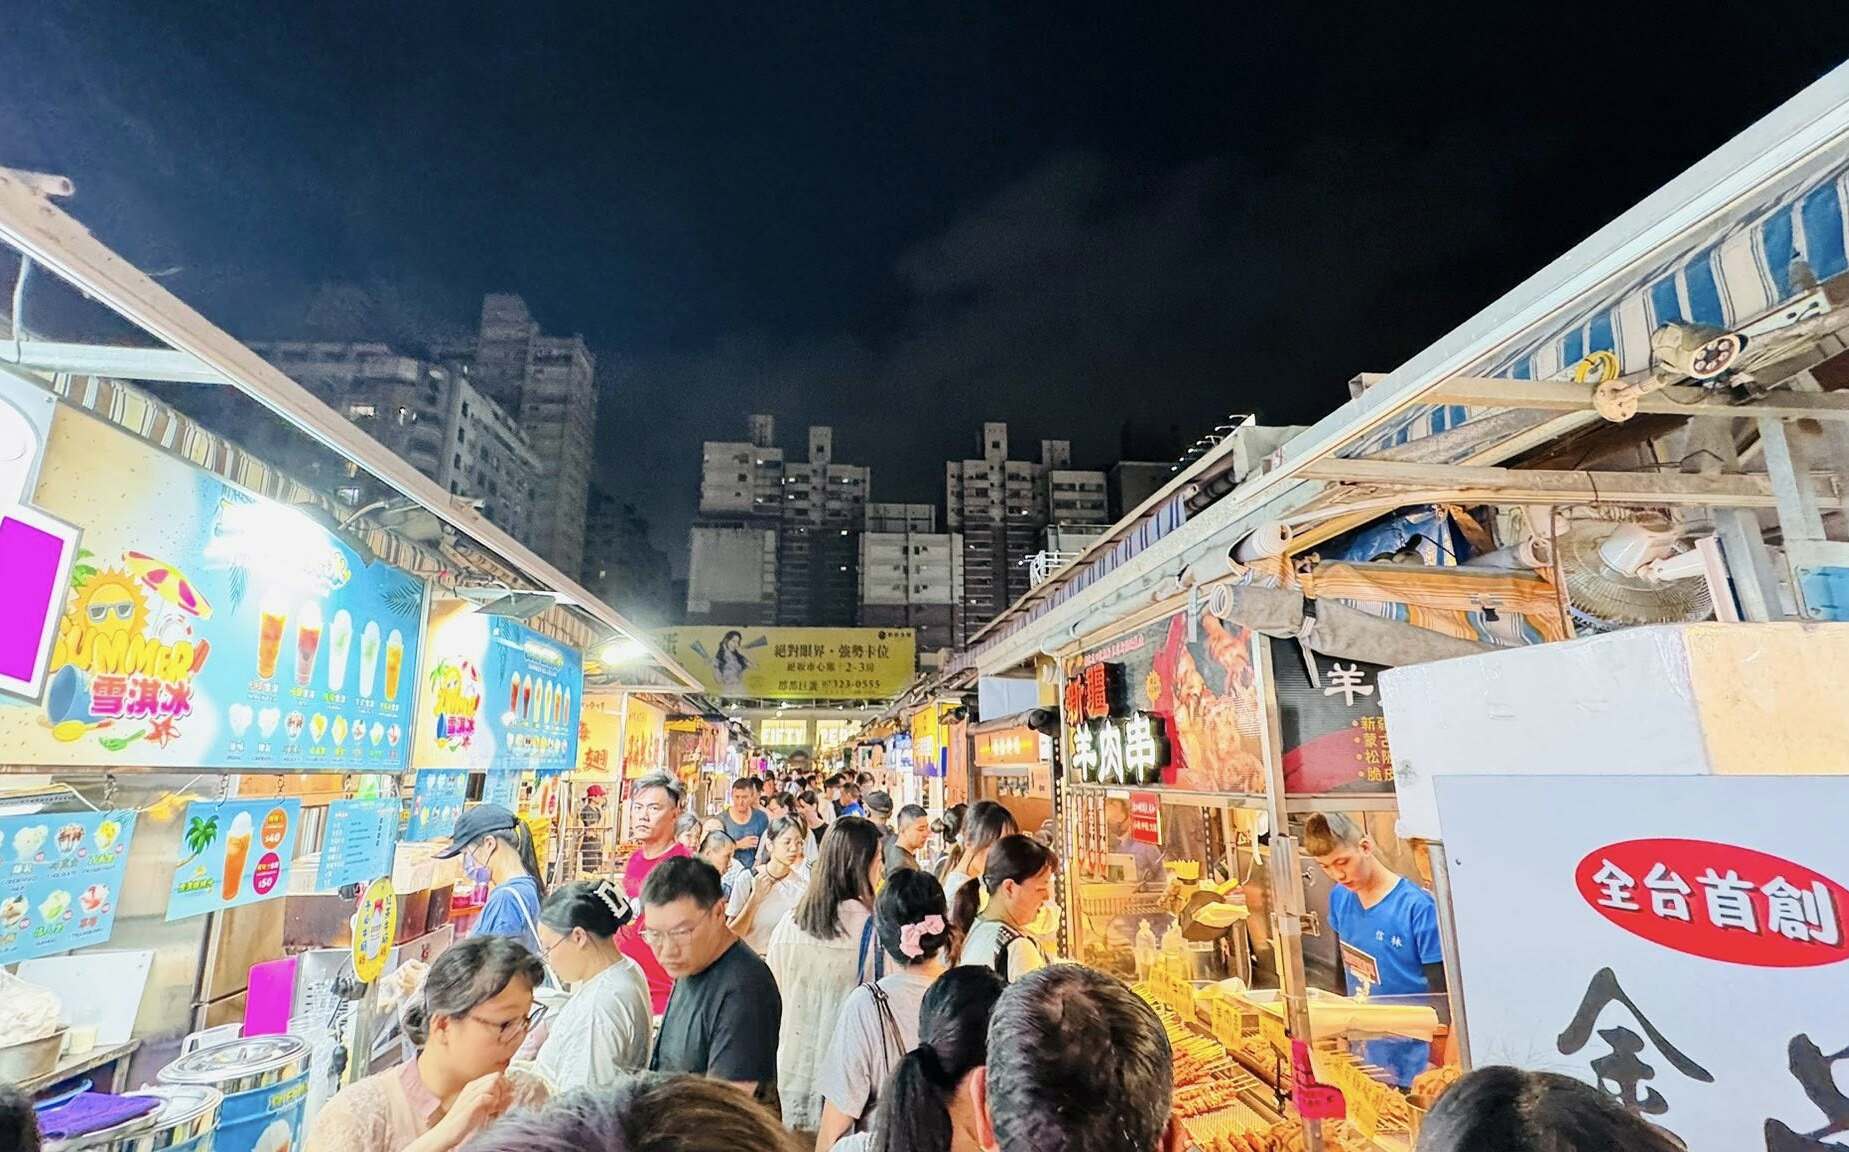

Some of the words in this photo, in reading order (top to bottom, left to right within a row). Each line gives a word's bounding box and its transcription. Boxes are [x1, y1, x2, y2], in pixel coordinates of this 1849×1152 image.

[50, 616, 194, 682] SUMMER
[91, 675, 192, 717] 雪淇冰
[1322, 662, 1382, 707] 羊
[1072, 711, 1156, 785] 羊肉串
[1591, 857, 1840, 945] 全台首創
